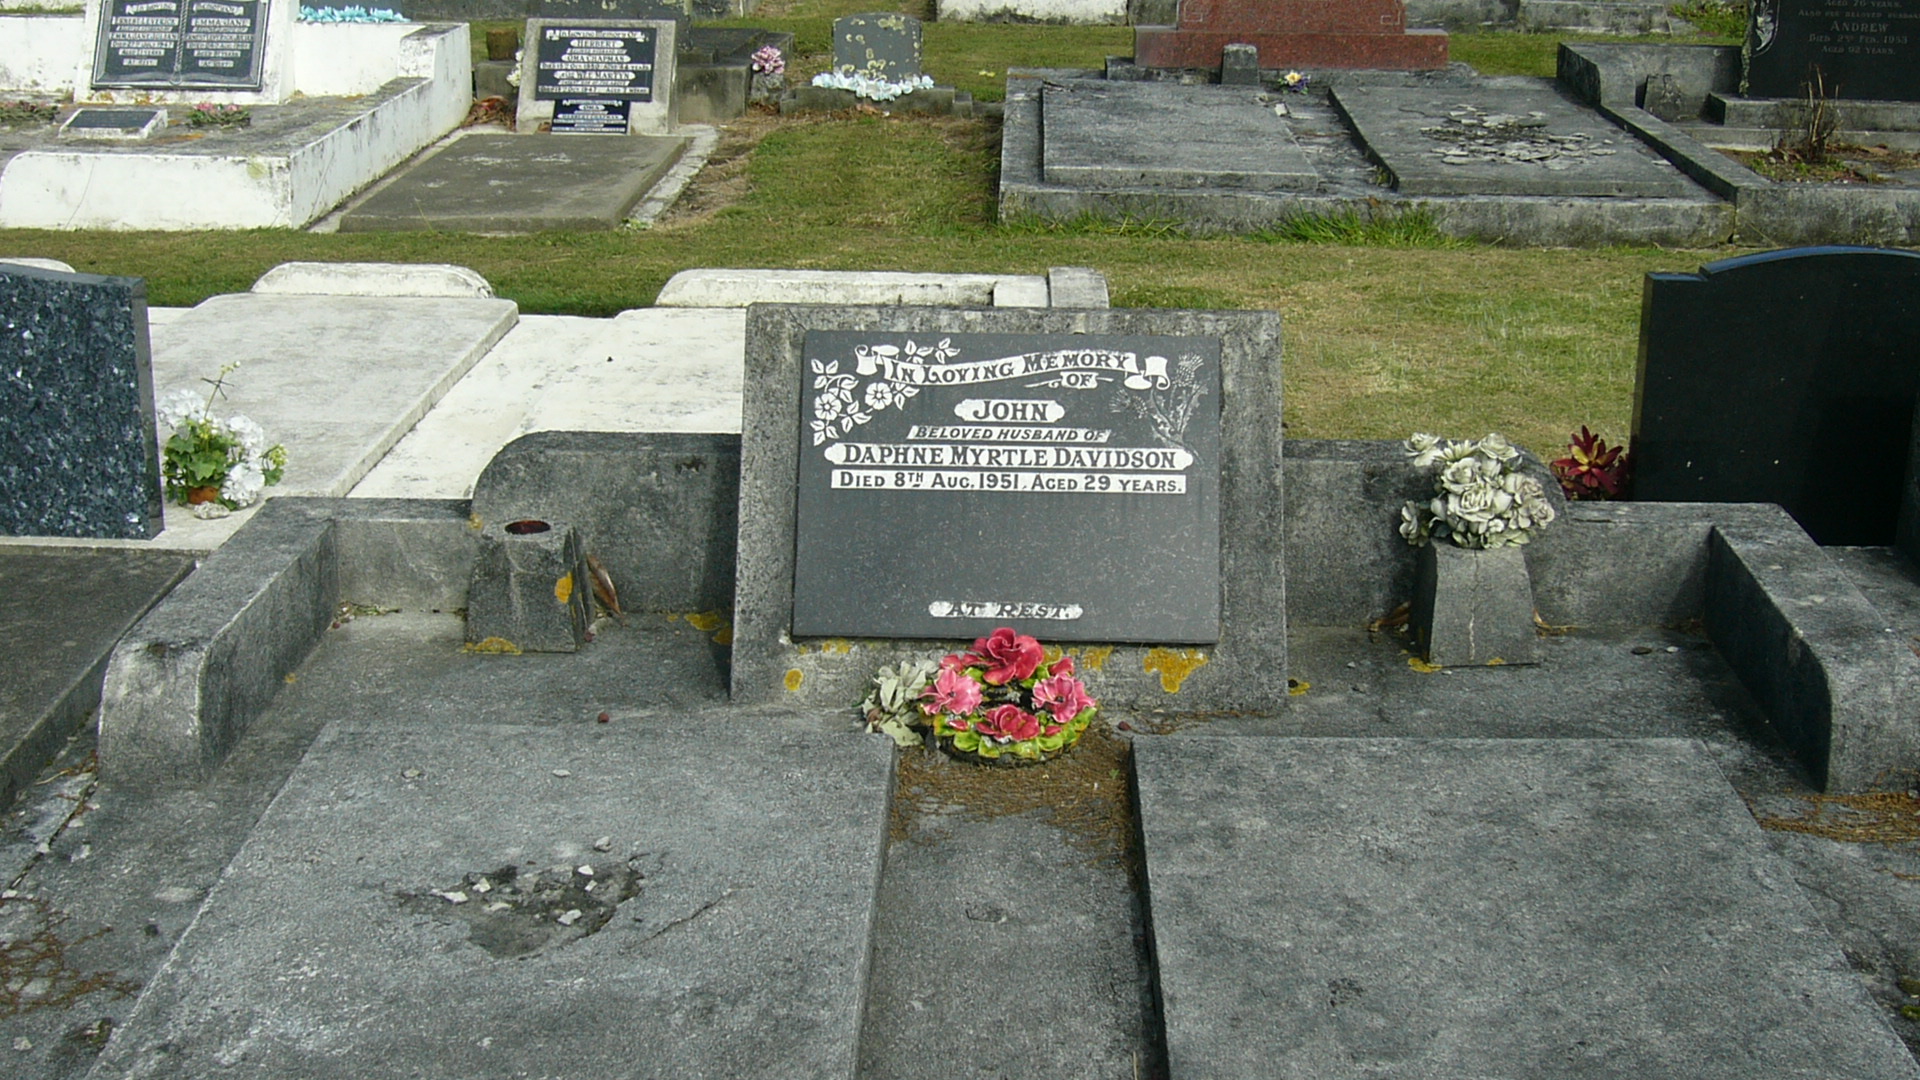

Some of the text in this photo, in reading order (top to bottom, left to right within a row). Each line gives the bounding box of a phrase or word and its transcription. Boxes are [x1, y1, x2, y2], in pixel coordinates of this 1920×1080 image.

[1830, 20, 1890, 33] ANDREW
[890, 350, 1132, 384] IN LOVING MEMORY
[1065, 373, 1094, 388] OF
[971, 401, 1049, 422] JOHN
[914, 426, 1108, 442] BELOVED HUSBAND OF
[843, 444, 1177, 469] DAPHNE MYRTLE DAVIDSON
[839, 472, 886, 488] DIED
[1030, 476, 1079, 491] AGED
[1083, 475, 1111, 491] 29
[1117, 478, 1184, 493] YEARS.
[945, 602, 986, 616] AT
